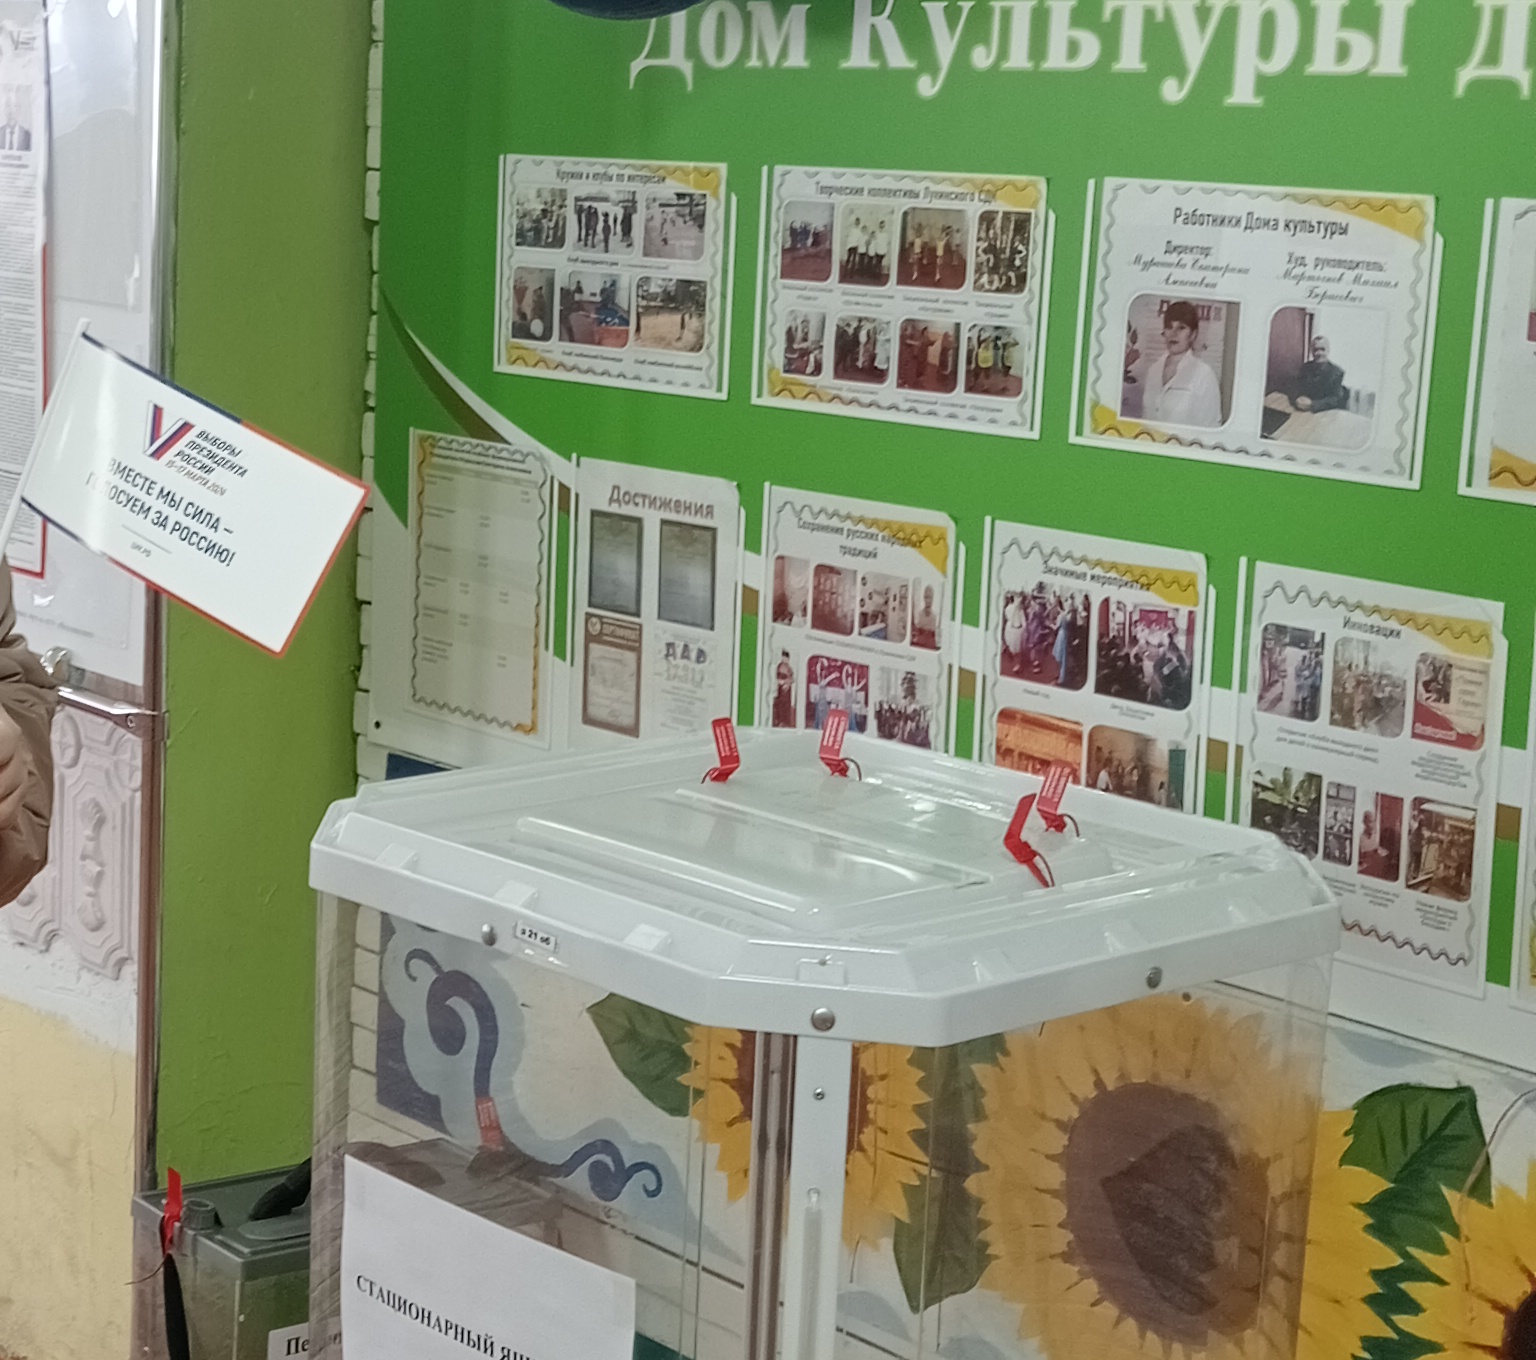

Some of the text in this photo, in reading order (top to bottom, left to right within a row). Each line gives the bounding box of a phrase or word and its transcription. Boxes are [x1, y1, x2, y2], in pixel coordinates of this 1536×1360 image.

[629, 0, 812, 92] Дом
[1173, 207, 1350, 240] Работники Дома культуры
[184, 440, 248, 478] ПРЕЗИДЕНТА
[195, 430, 243, 458] ВЫБОРЫ
[173, 449, 216, 476] РОССИИ
[183, 468, 210, 487] МАРТА
[108, 457, 158, 497] ВМЕСТЕ
[155, 485, 185, 512] МЫ
[182, 501, 222, 534] СИЛА
[608, 484, 714, 520] Достижения
[85, 471, 237, 568] ГОСУЕМ ЗА РОССИЮ!
[1342, 615, 1402, 640] Инновации
[356, 1274, 495, 1358] СТАЦИОНАРНЫЙ
